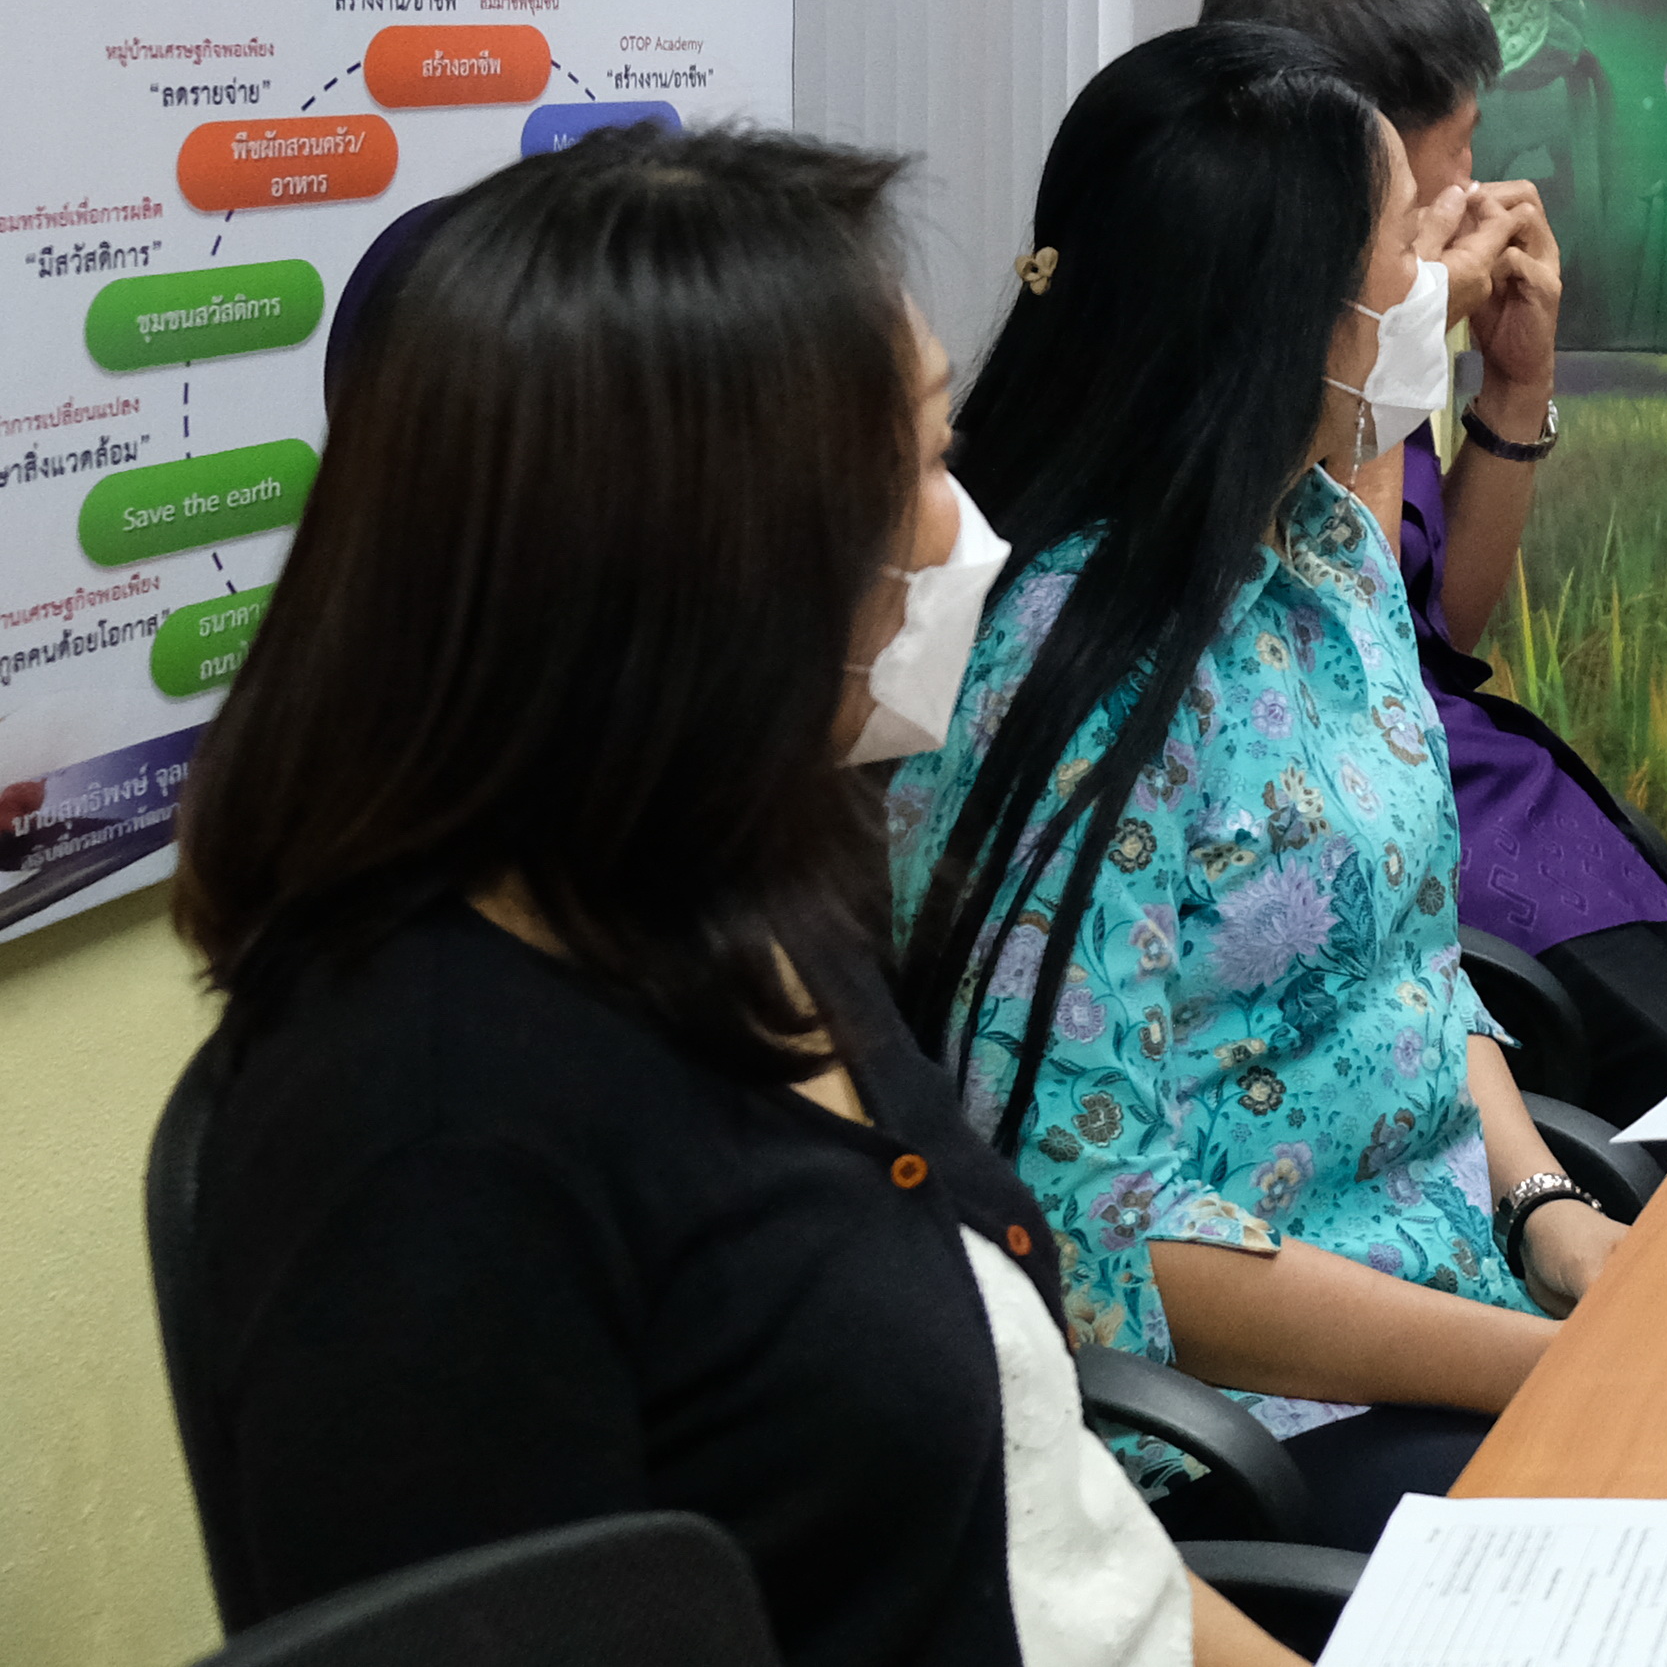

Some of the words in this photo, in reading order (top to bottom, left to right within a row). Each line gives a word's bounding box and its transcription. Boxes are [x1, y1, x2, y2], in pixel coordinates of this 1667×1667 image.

[620, 36, 651, 52] OTOP
[655, 36, 703, 54] Academy
[421, 50, 502, 78] สร้างอาชีพ
[231, 127, 366, 160] พืชผักสวนครัว/
[271, 173, 328, 197] อาหาร
[136, 294, 281, 344] ชุมชนสวัสดิการ
[122, 505, 175, 533] Save
[183, 487, 219, 516] the
[227, 476, 282, 508] earth
